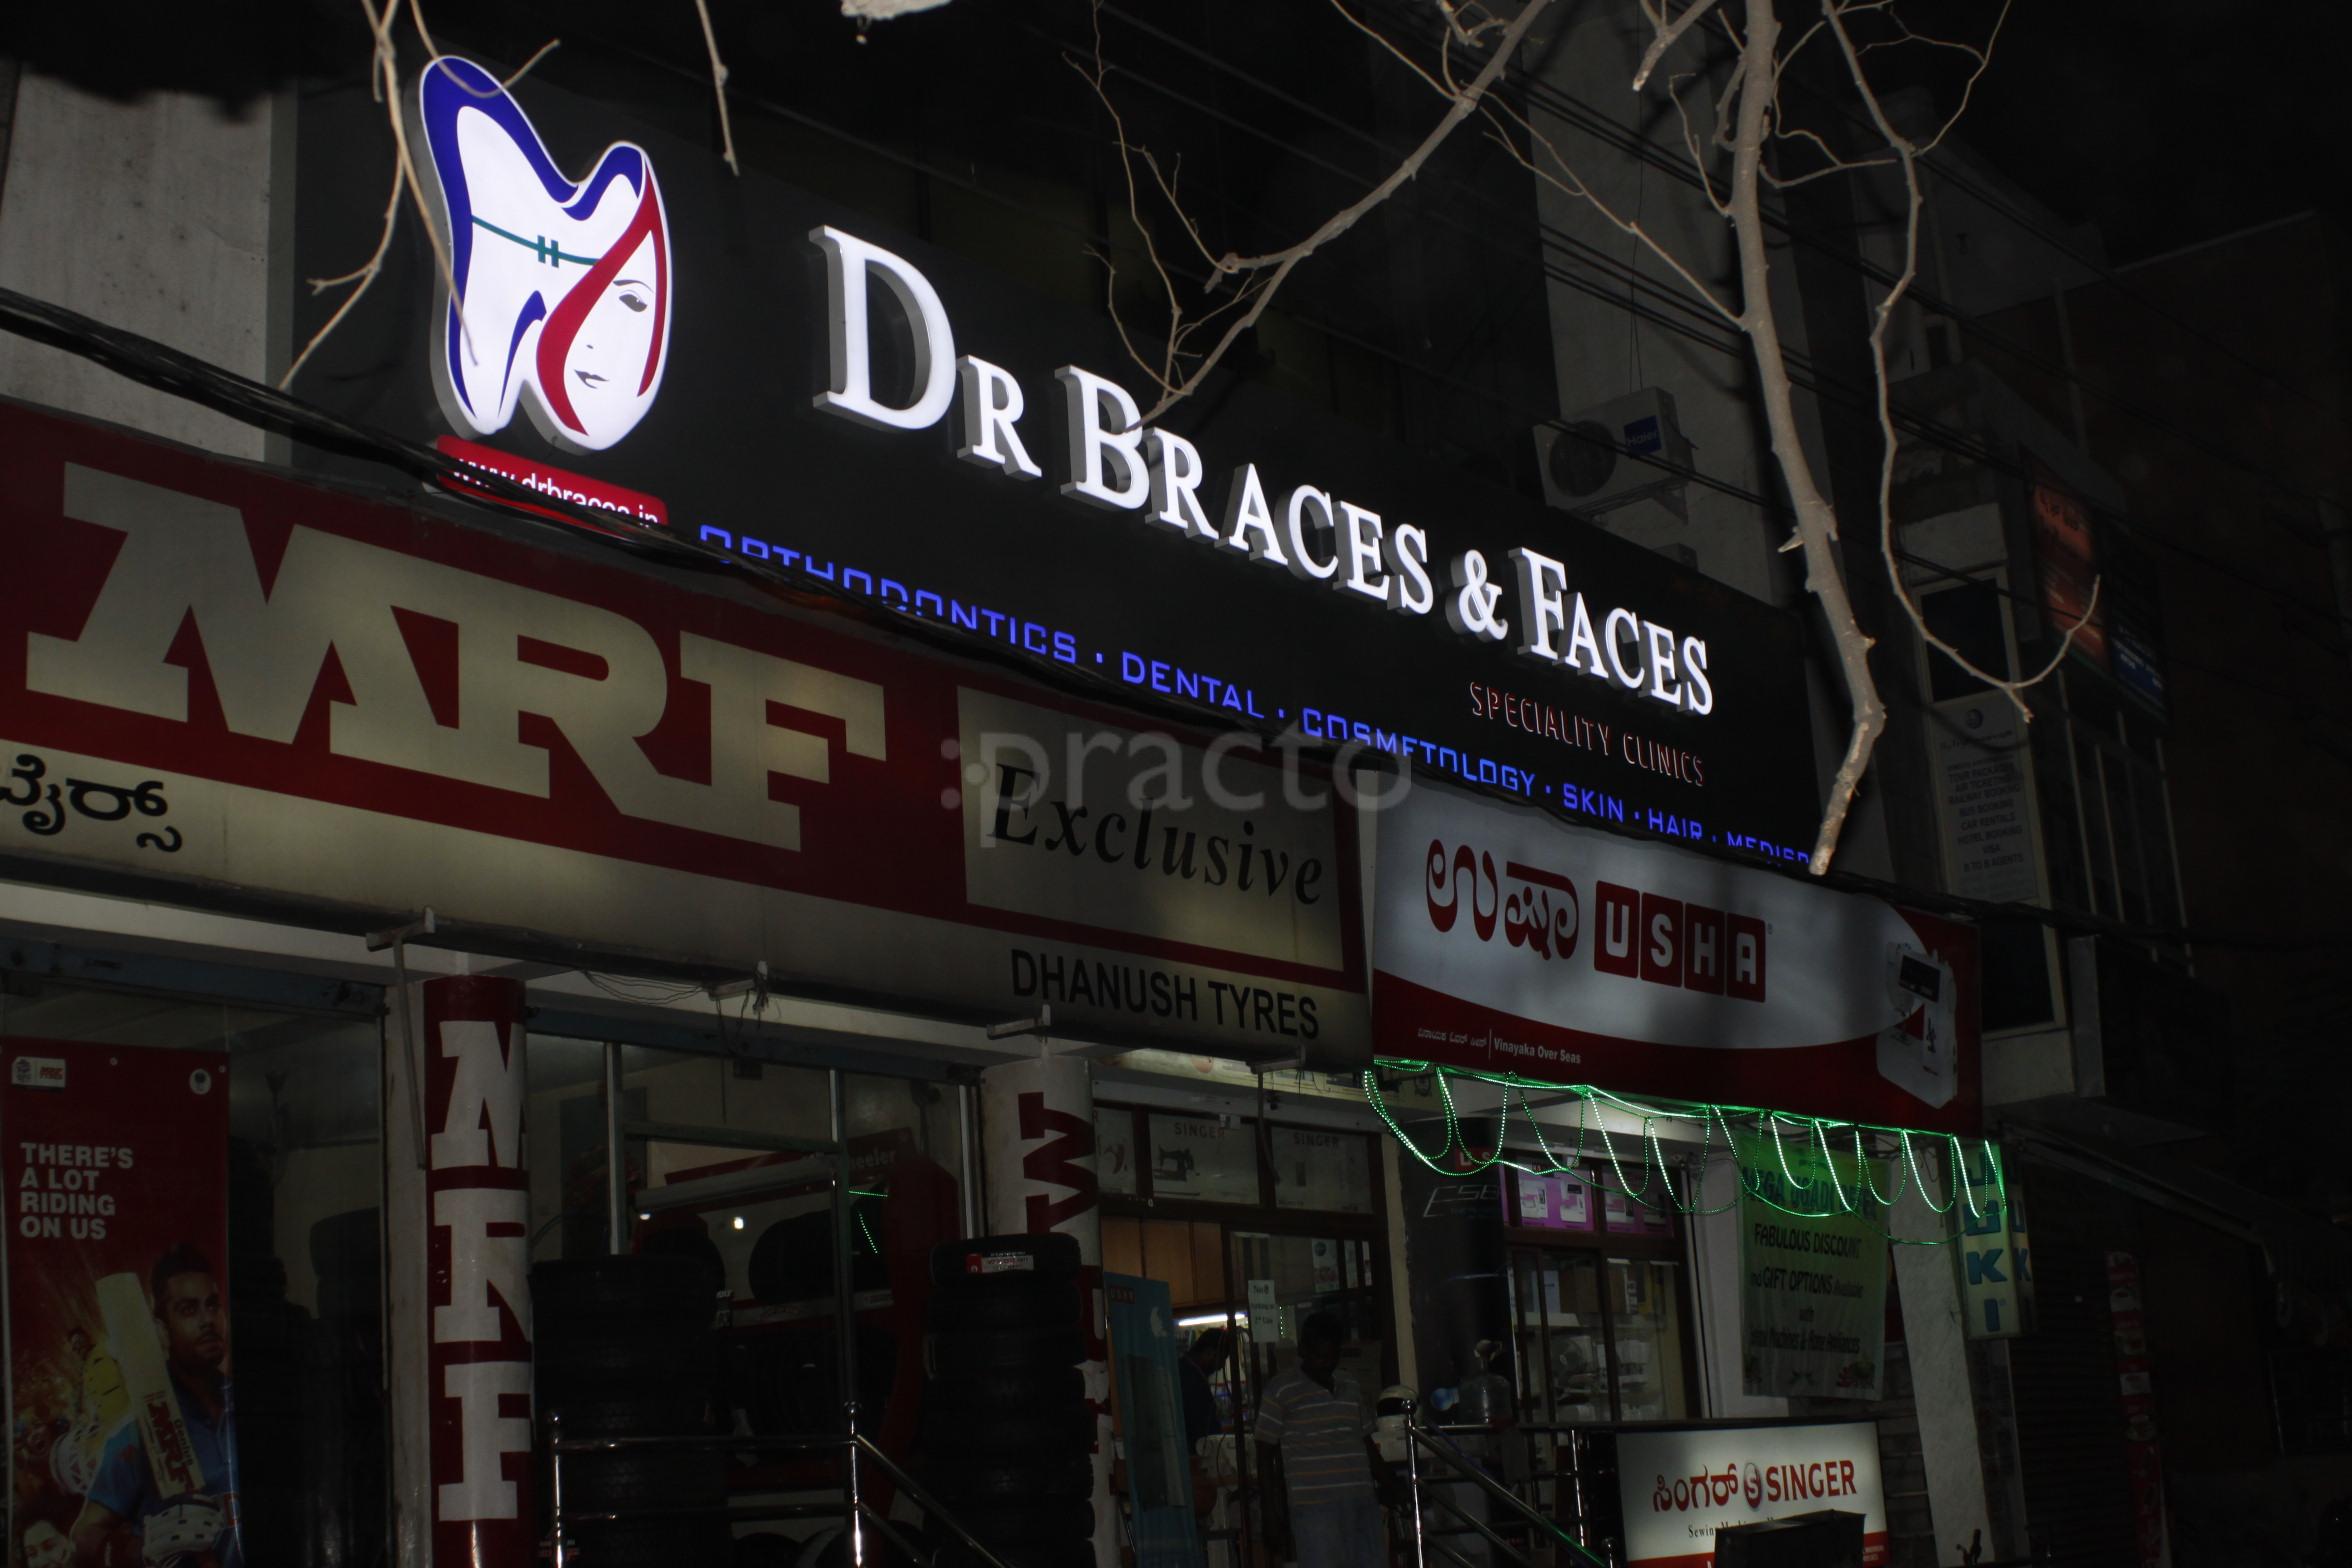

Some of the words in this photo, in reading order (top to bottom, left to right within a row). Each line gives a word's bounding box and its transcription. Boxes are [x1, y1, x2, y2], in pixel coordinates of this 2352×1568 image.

[810, 225, 1041, 480] DR
[1055, 365, 1433, 615] BRACES
[1447, 550, 1508, 641] &
[1509, 547, 1713, 716] FACES
[26, 461, 887, 852] MRF
[1122, 651, 1265, 719] DENTAL
[1302, 707, 1534, 797] COSMETOLOGY
[1563, 784, 1624, 824] SKIN
[1649, 808, 1703, 840] HAIR
[1470, 681, 1611, 756] SPECIALITY
[1623, 733, 1704, 788] CLINICS
[988, 763, 1323, 905] Exclusive
[1602, 900, 1760, 988] USHA
[1012, 949, 1198, 1020] DHANUSH
[1208, 980, 1319, 1039] TYRES
[1494, 1037, 1535, 1057] Vinayaka
[1538, 1045, 1558, 1060] Over
[1560, 1049, 1582, 1064] Seas
[1174, 1121, 1225, 1139] SINGER
[1294, 1132, 1339, 1148] SINGER
[19, 1141, 134, 1169] THERE'S
[19, 1166, 39, 1189] A
[48, 1168, 100, 1191] LOT
[20, 1191, 116, 1216] RIDING
[19, 1215, 62, 1238] ON
[70, 1217, 107, 1240] US
[1755, 1223, 1811, 1252] FABULOUS
[1814, 1231, 1863, 1260] DISCOUNT
[431, 1019, 533, 1522] MRF
[1762, 1267, 1787, 1290] GIFT
[1789, 1270, 1833, 1295] OPTIONS
[1653, 1463, 1739, 1512] ಸಿಂಗರ್
[1766, 1460, 1857, 1502] SINGER
[1688, 1523, 1716, 1538] Sewin
